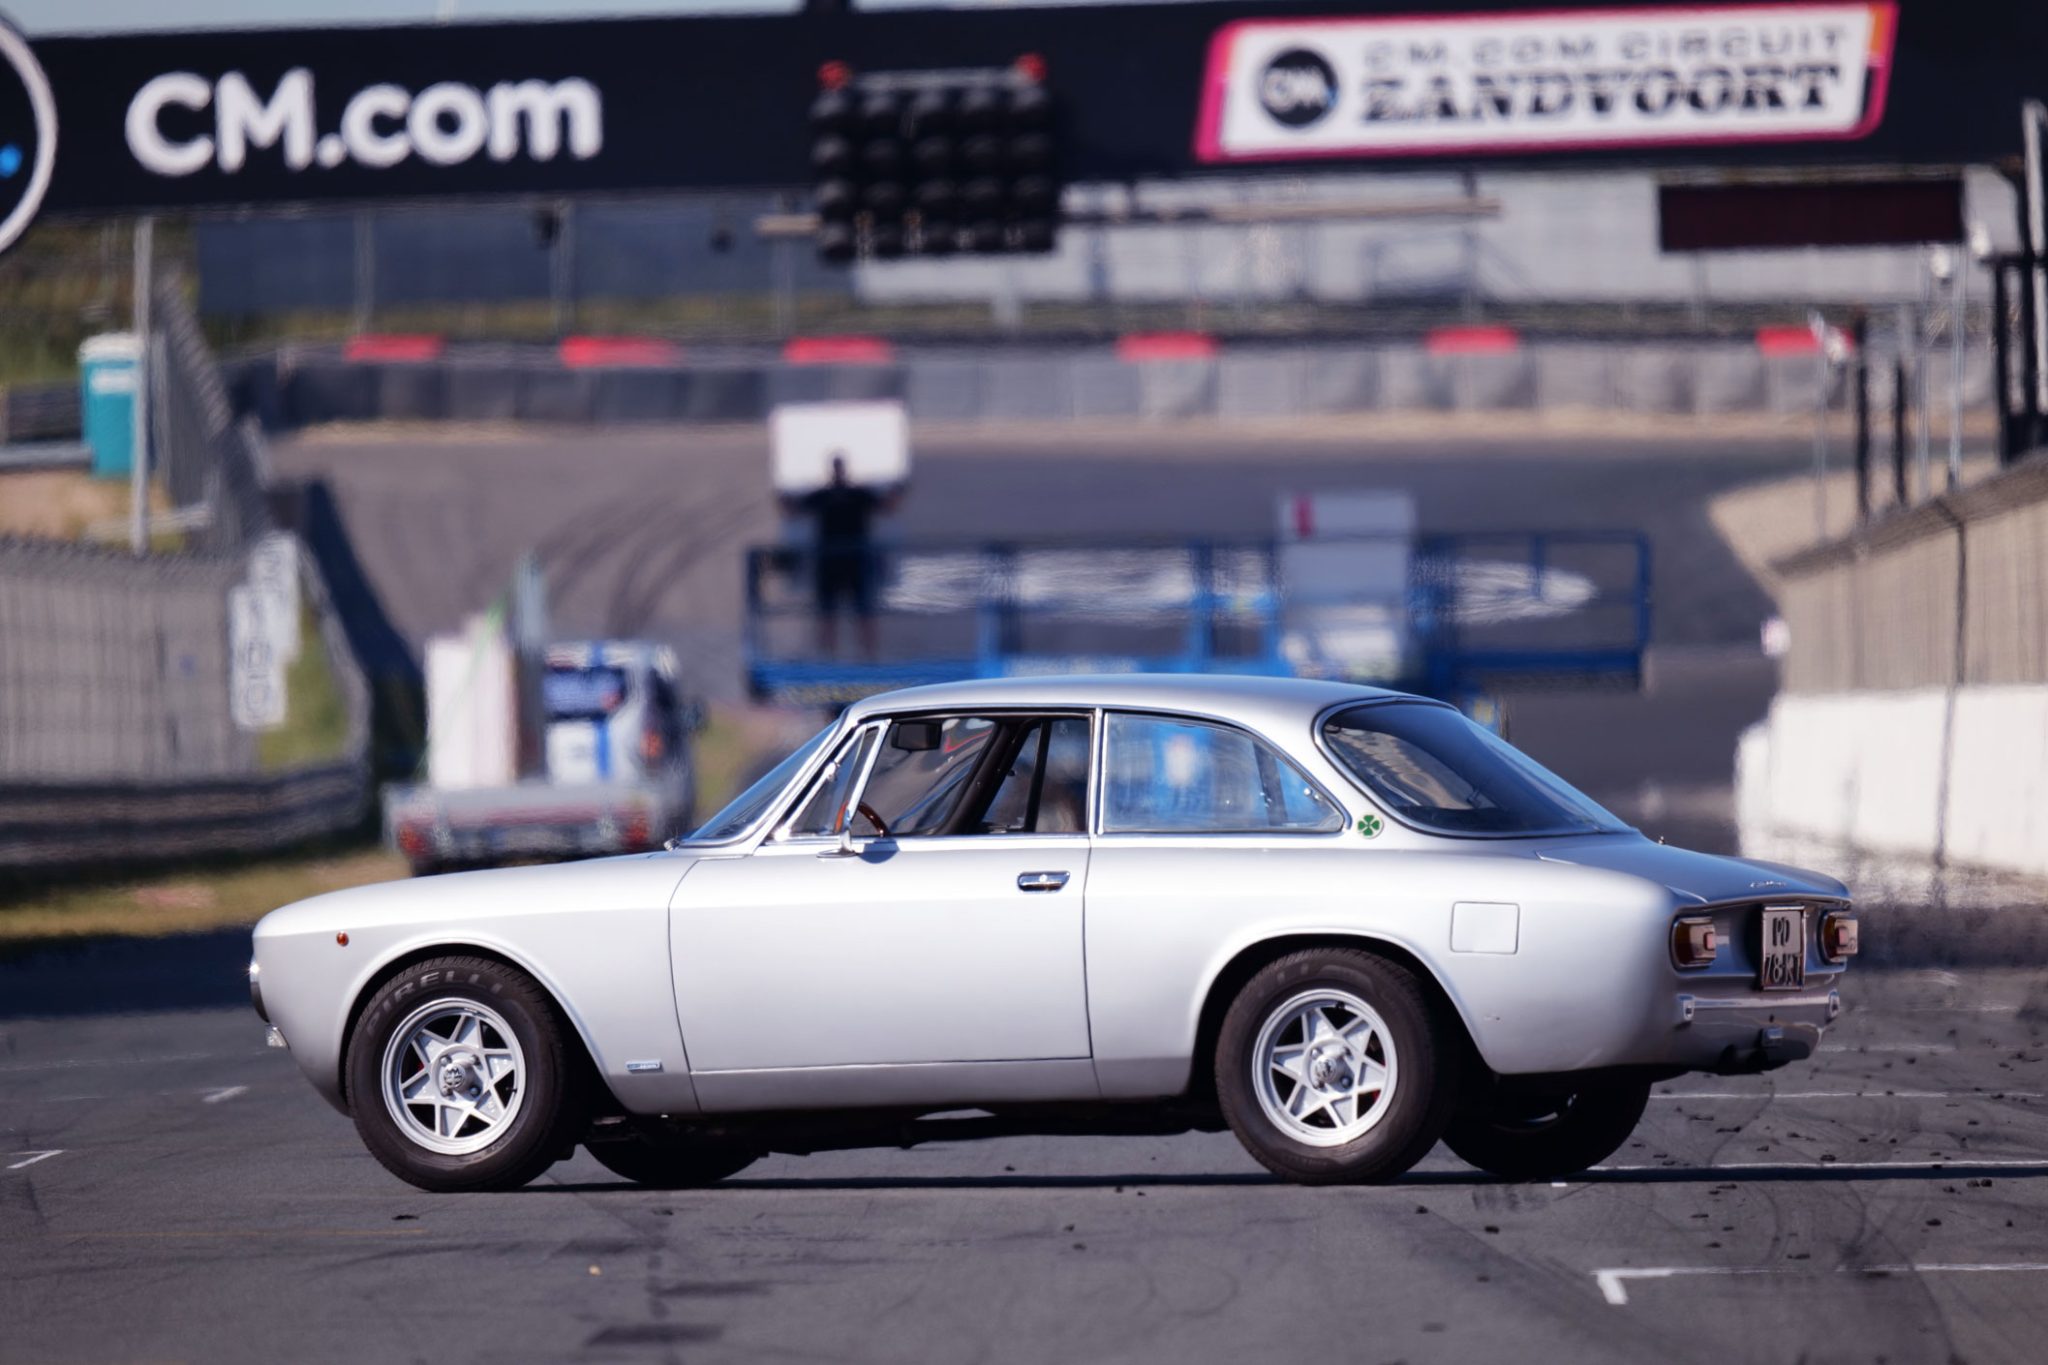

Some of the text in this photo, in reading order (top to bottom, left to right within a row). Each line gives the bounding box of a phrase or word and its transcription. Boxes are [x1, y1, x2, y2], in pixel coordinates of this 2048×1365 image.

[1621, 25, 1846, 60] CIRCUIT
[126, 67, 602, 176] CM.com
[1363, 63, 1838, 123] ZANDVOORT
[366, 970, 503, 1035] PIRELLI
